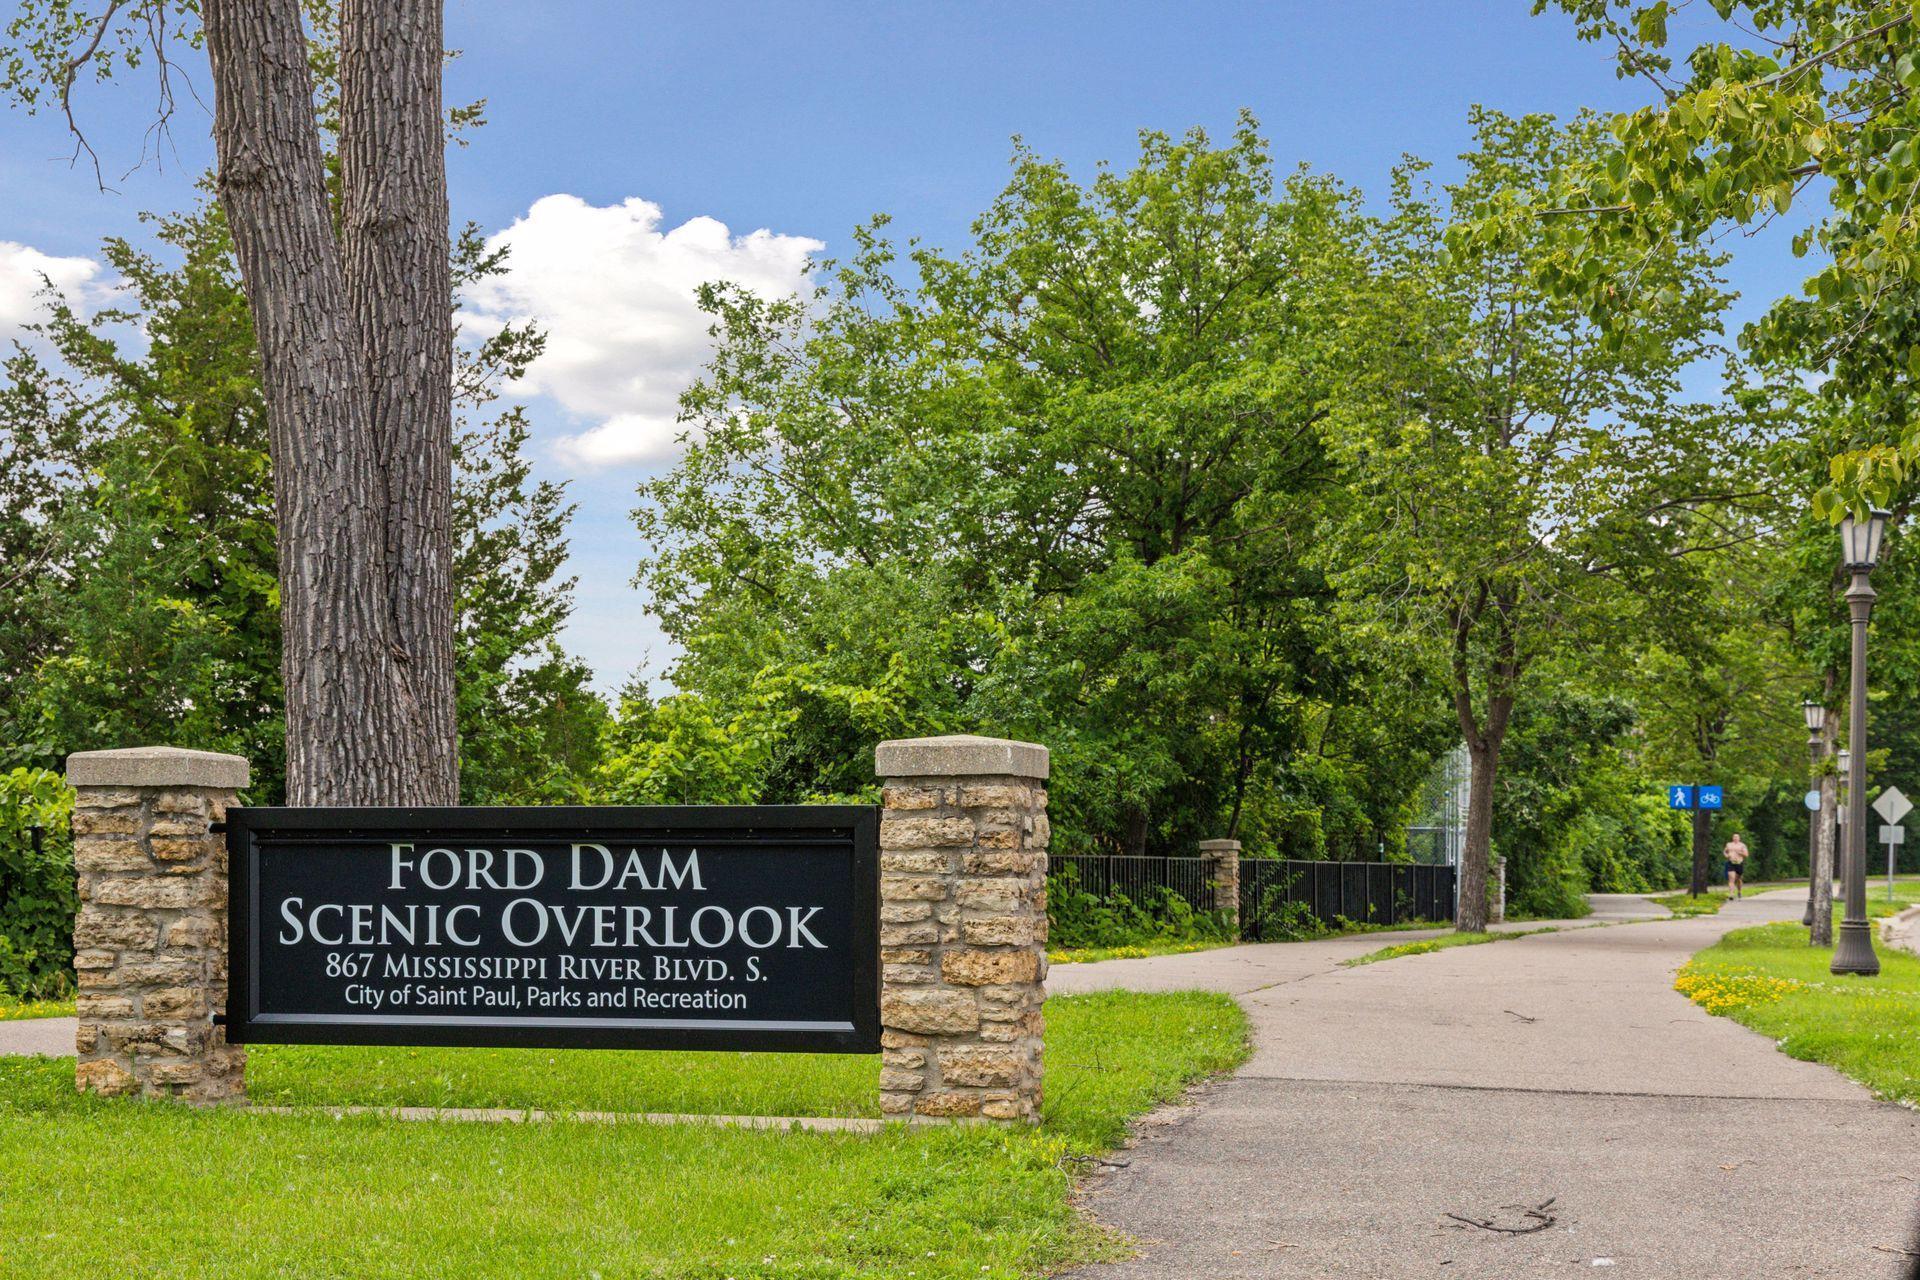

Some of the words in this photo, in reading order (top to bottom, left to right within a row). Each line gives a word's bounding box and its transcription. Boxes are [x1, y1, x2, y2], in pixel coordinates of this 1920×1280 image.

[388, 844, 544, 890] FORD
[567, 844, 708, 890] DAM
[279, 896, 481, 947] SCENIC
[502, 898, 828, 949] OVERLOOK
[326, 953, 375, 978] 867
[383, 953, 548, 980] MISSISSIPPI
[558, 955, 645, 981] RIVER
[653, 956, 735, 982] BLVD.
[747, 956, 768, 982] S.
[344, 983, 385, 1010] City
[390, 983, 412, 1006] of
[415, 984, 468, 1006] Saint
[474, 984, 521, 1010] Paul,
[528, 985, 582, 1008] Parks
[587, 986, 627, 1008] and
[634, 987, 747, 1010] Recreation
